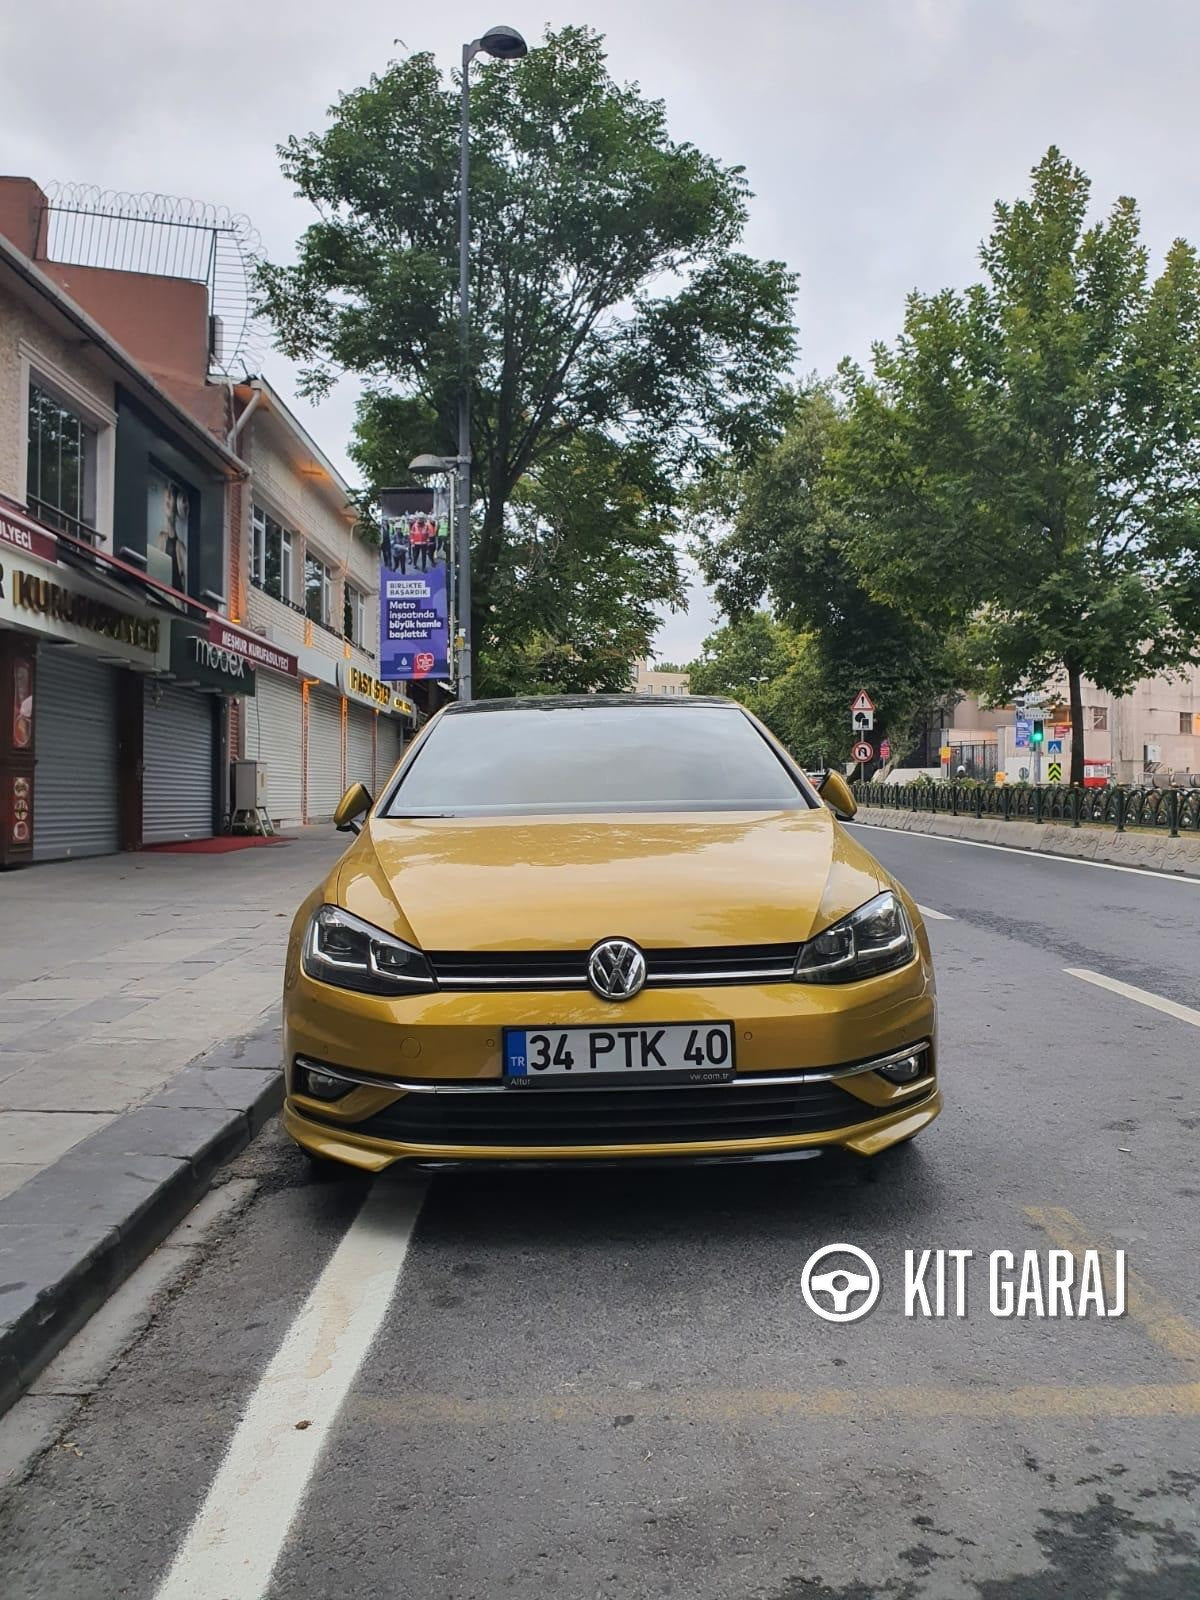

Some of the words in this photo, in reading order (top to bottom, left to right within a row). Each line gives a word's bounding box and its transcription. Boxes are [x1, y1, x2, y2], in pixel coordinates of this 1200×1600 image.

[389, 601, 416, 609] Metro
[389, 620, 415, 630] büyük
[416, 619, 442, 628] hamle
[389, 630, 428, 639] başlattık
[221, 630, 248, 654] MEŞHUR
[510, 1056, 525, 1067] TR
[529, 1033, 574, 1071] 34
[589, 1030, 667, 1069] PTK
[683, 1029, 728, 1065] 40
